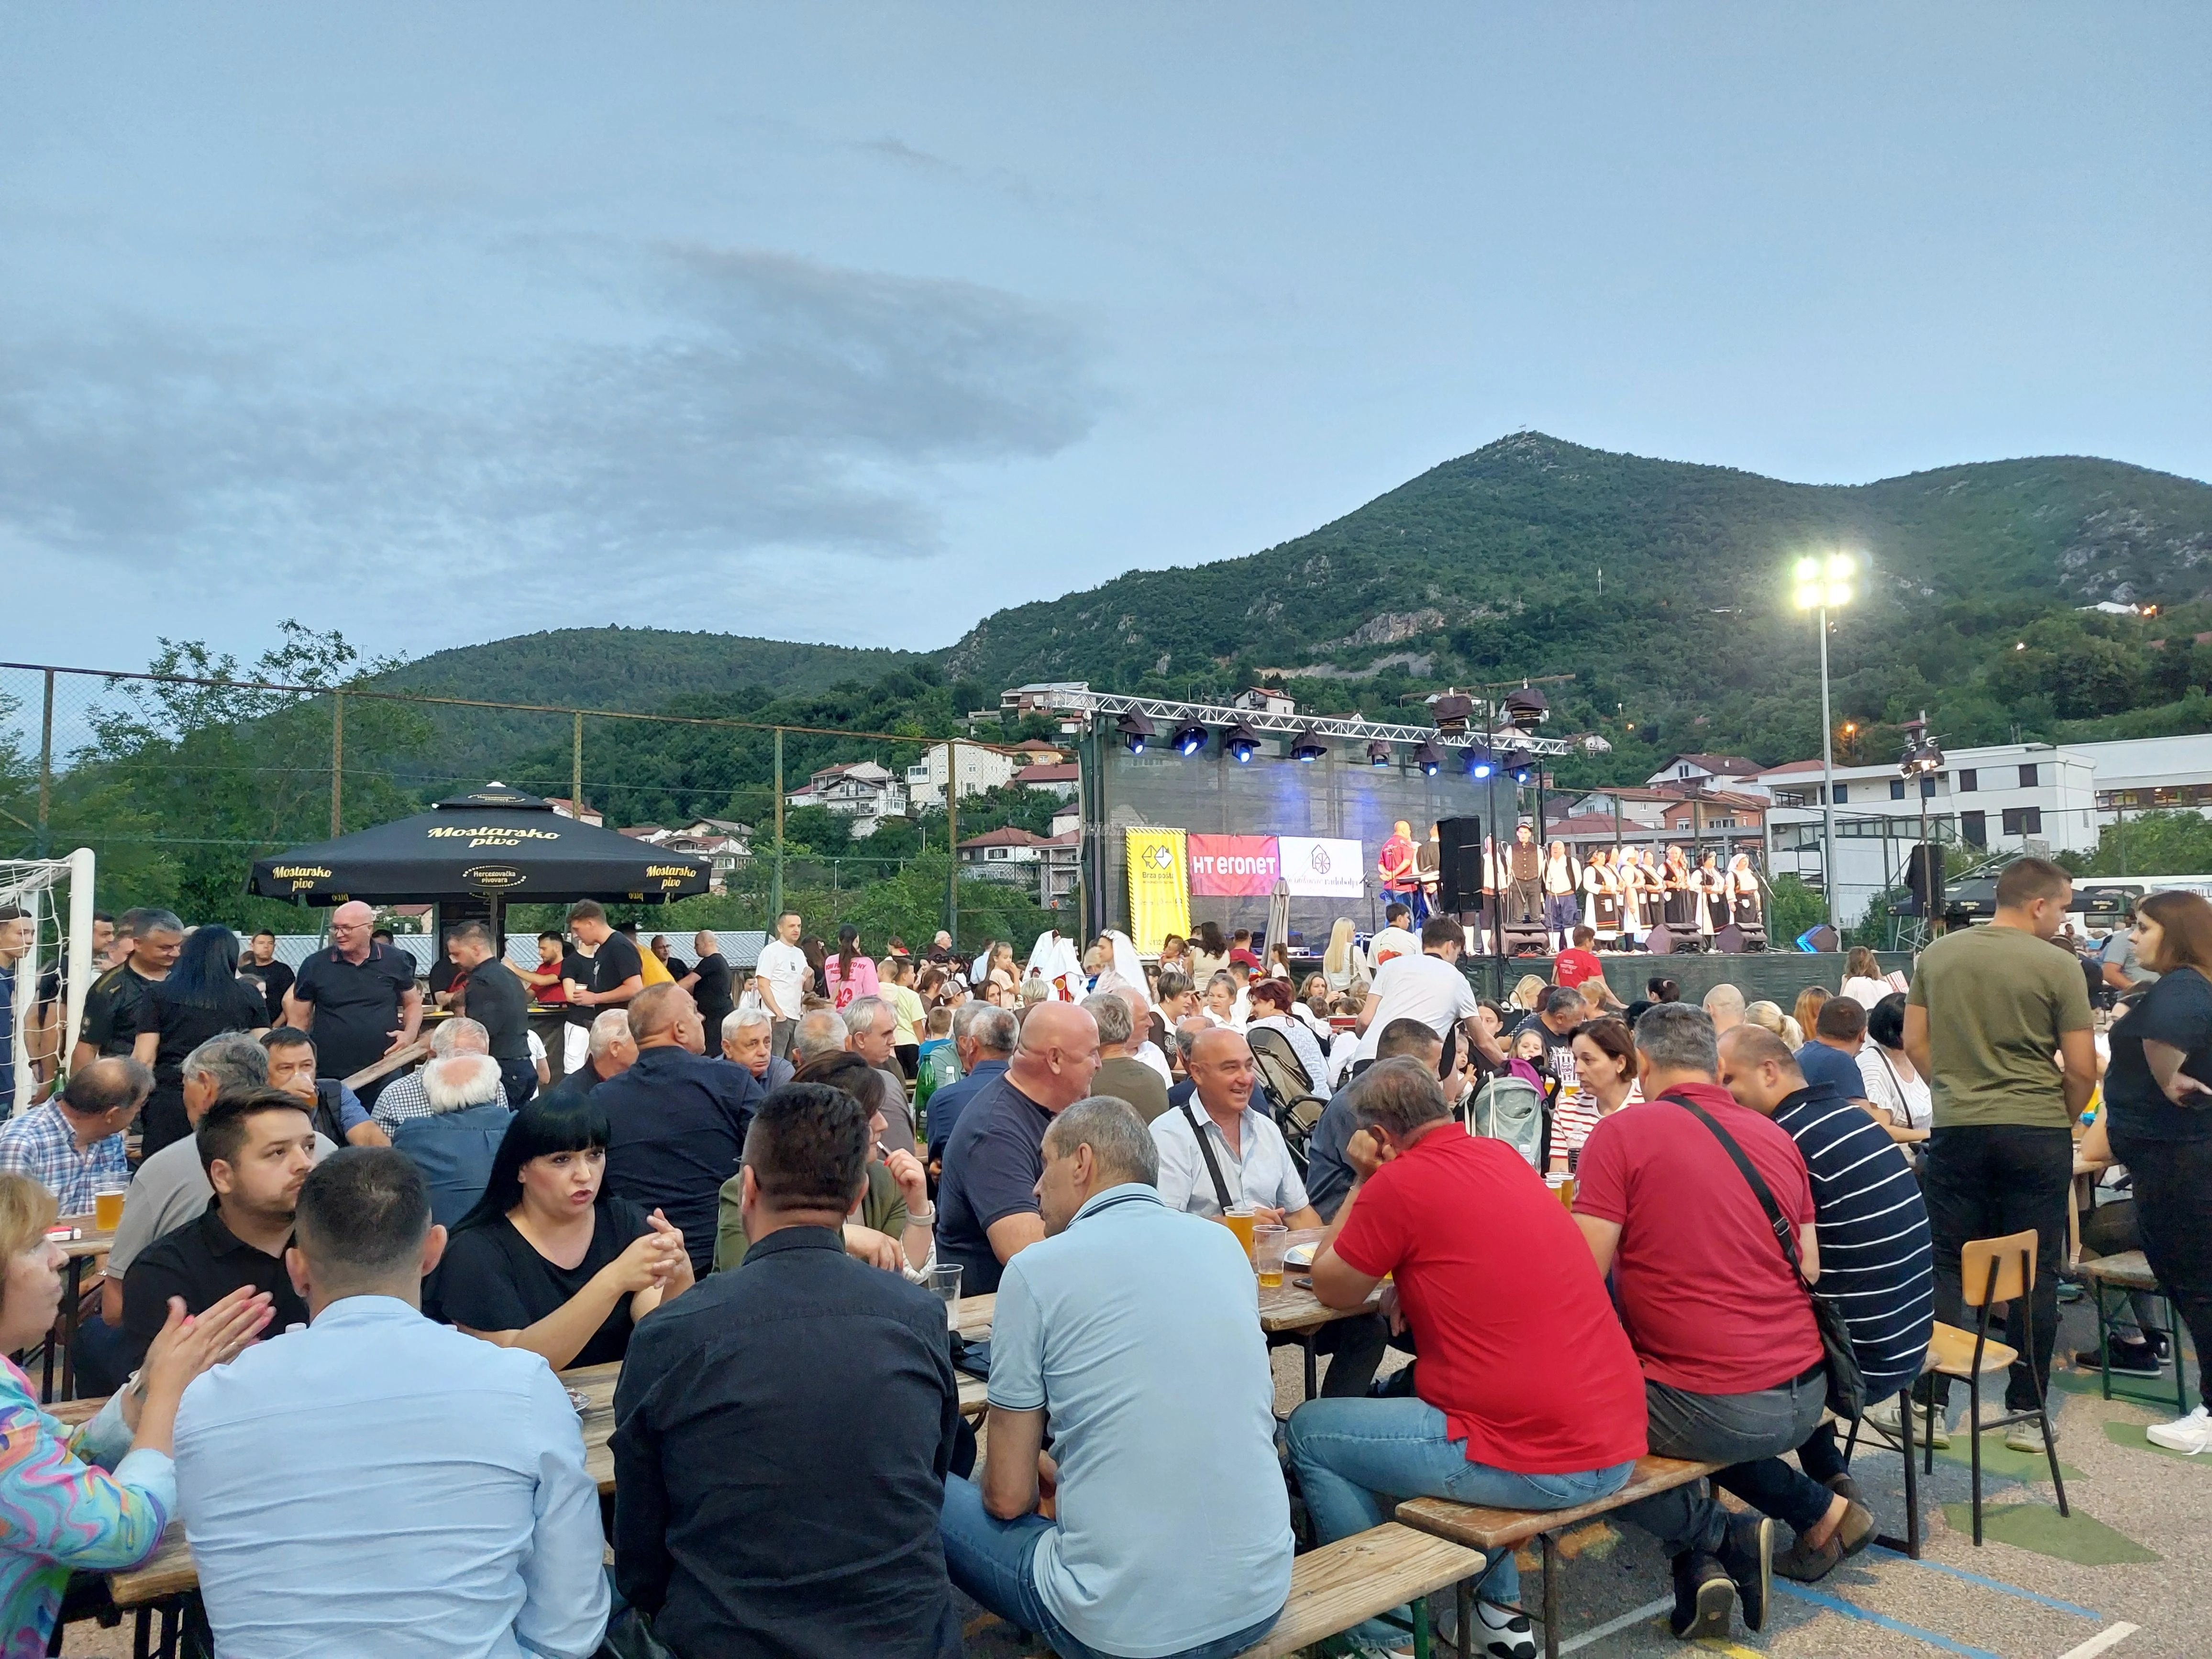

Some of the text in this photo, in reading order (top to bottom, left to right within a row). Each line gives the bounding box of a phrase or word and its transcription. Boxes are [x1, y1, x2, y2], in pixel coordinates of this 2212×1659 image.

[427, 826, 561, 840] Mostarsko
[468, 836, 521, 848] pivo
[646, 865, 697, 877] Mostarsko
[1193, 855, 1215, 874] HT
[273, 866, 332, 879] Mostarsko
[292, 877, 315, 892] pivo
[661, 877, 682, 890] pivo
[2186, 889, 2212, 898] RILL
